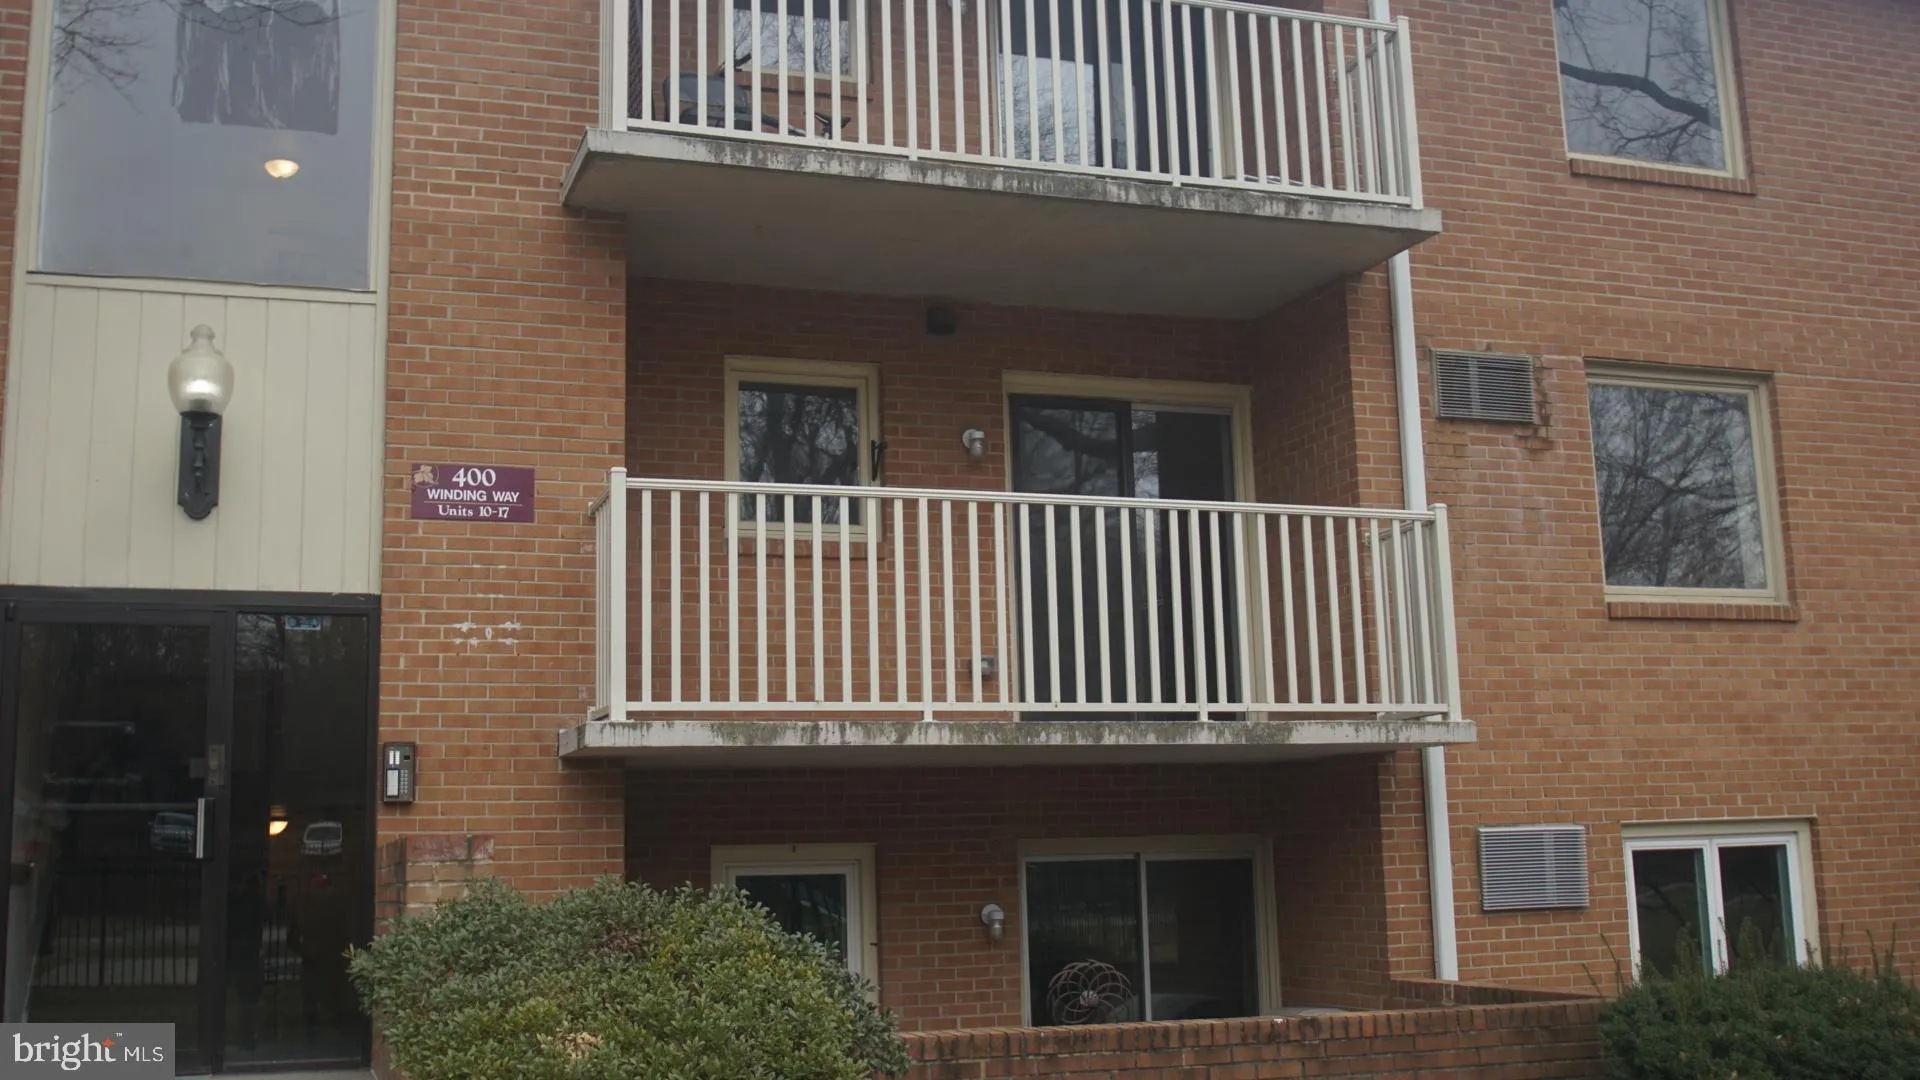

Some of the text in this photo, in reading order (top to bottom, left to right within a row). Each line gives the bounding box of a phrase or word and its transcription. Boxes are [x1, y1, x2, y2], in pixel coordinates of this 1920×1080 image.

[452, 467, 496, 487] 400
[427, 489, 520, 502] WINDING WAY
[438, 504, 509, 518] Units 10-17
